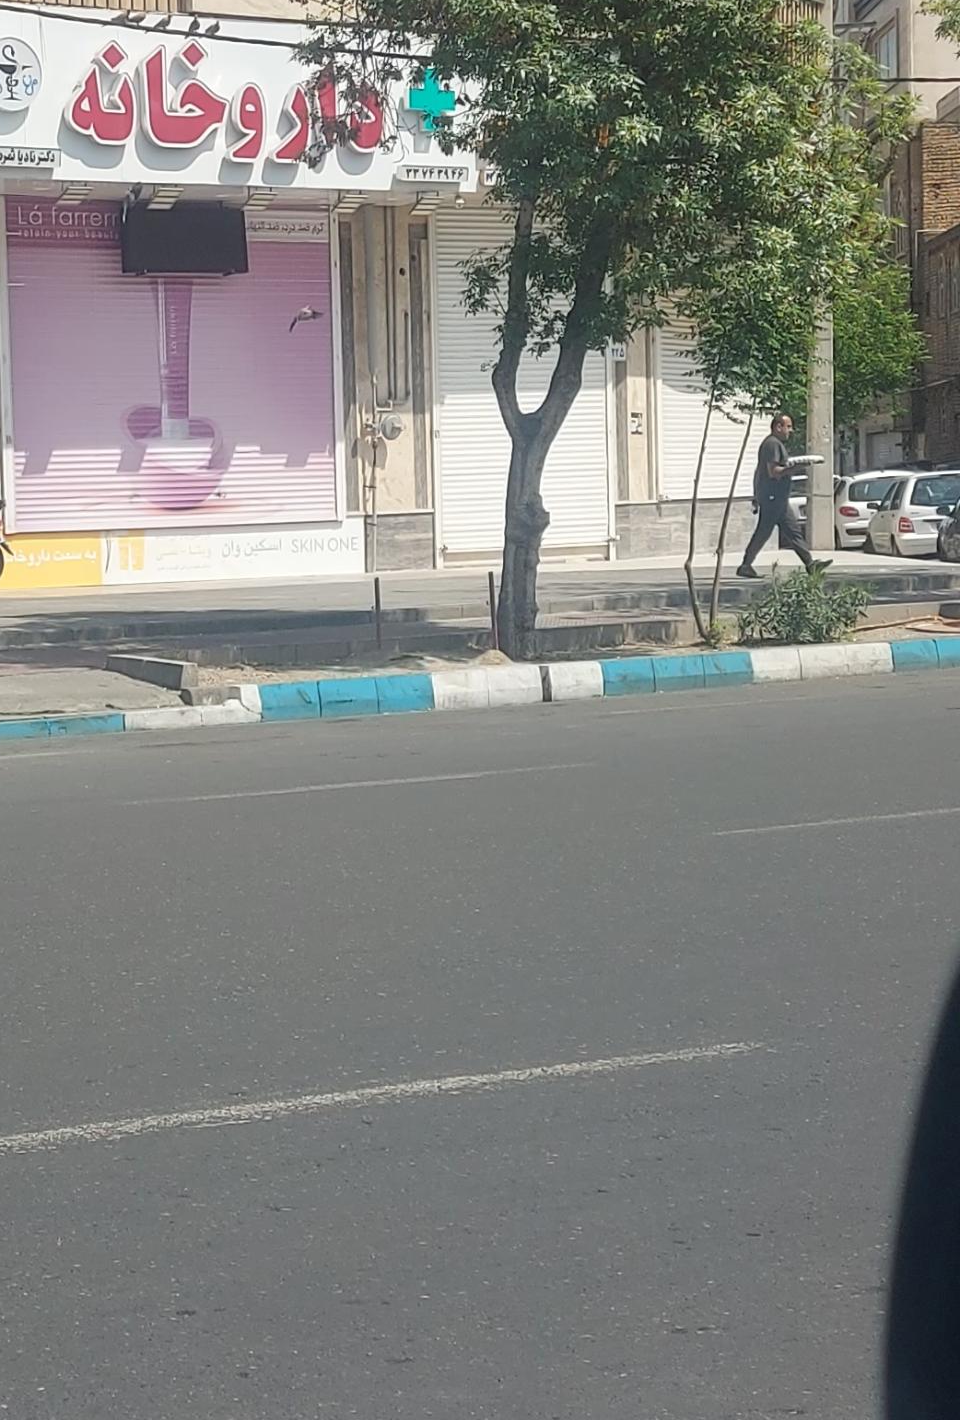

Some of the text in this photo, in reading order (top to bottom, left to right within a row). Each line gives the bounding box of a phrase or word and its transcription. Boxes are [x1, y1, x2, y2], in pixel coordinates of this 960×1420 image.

[71, 39, 384, 163] داروخانه
[17, 150, 36, 165] نادیا
[36, 150, 55, 166] دکتر
[221, 538, 282, 559] اسکین وان
[290, 536, 360, 554] SKIN ONE
